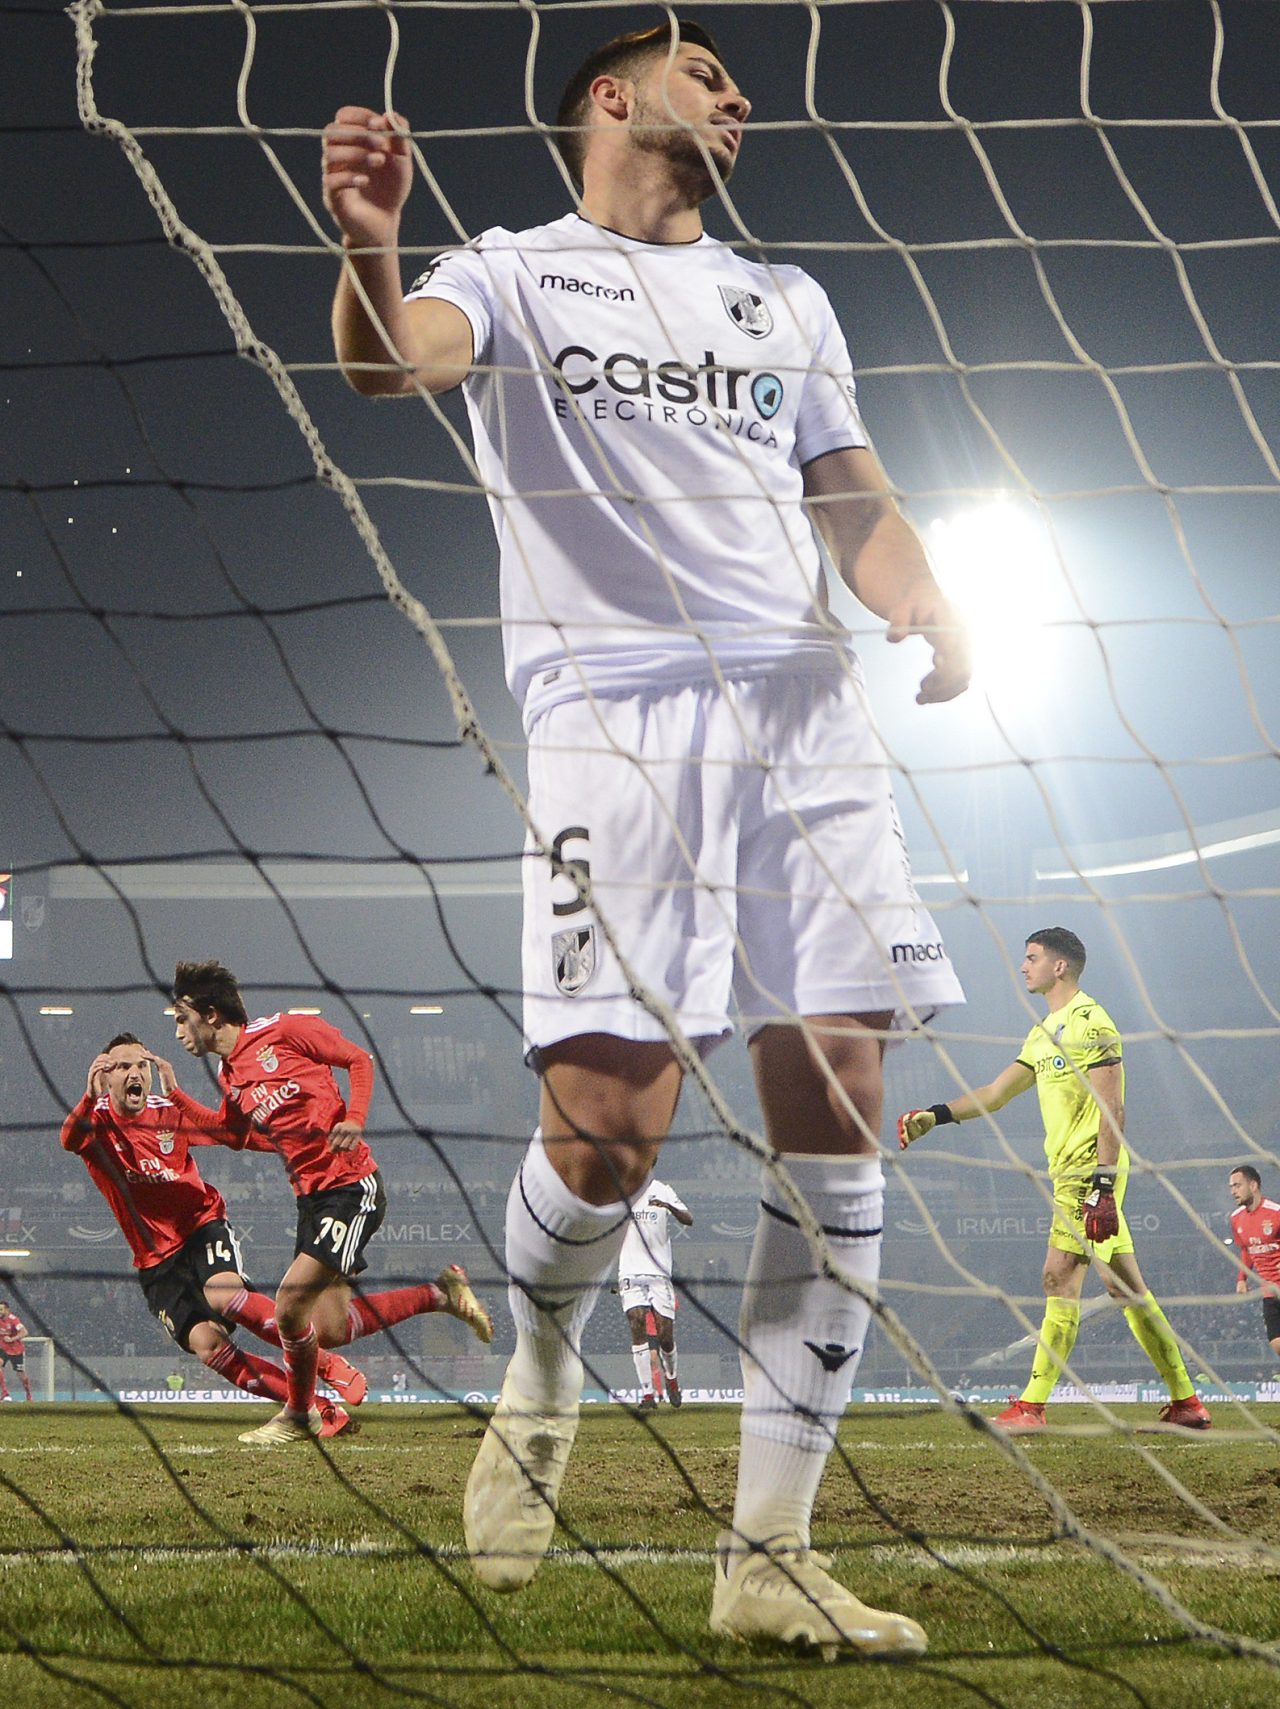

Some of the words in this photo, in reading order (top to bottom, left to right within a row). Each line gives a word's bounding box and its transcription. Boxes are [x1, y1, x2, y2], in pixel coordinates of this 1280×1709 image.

[540, 273, 635, 302] macron
[553, 345, 784, 421] castro
[891, 942, 944, 964] macr
[252, 1079, 301, 1125] mirates
[314, 1216, 348, 1254] 79
[376, 1223, 472, 1241] RMALEX
[957, 1217, 1049, 1235] IRMALE
[205, 1240, 232, 1266] 14
